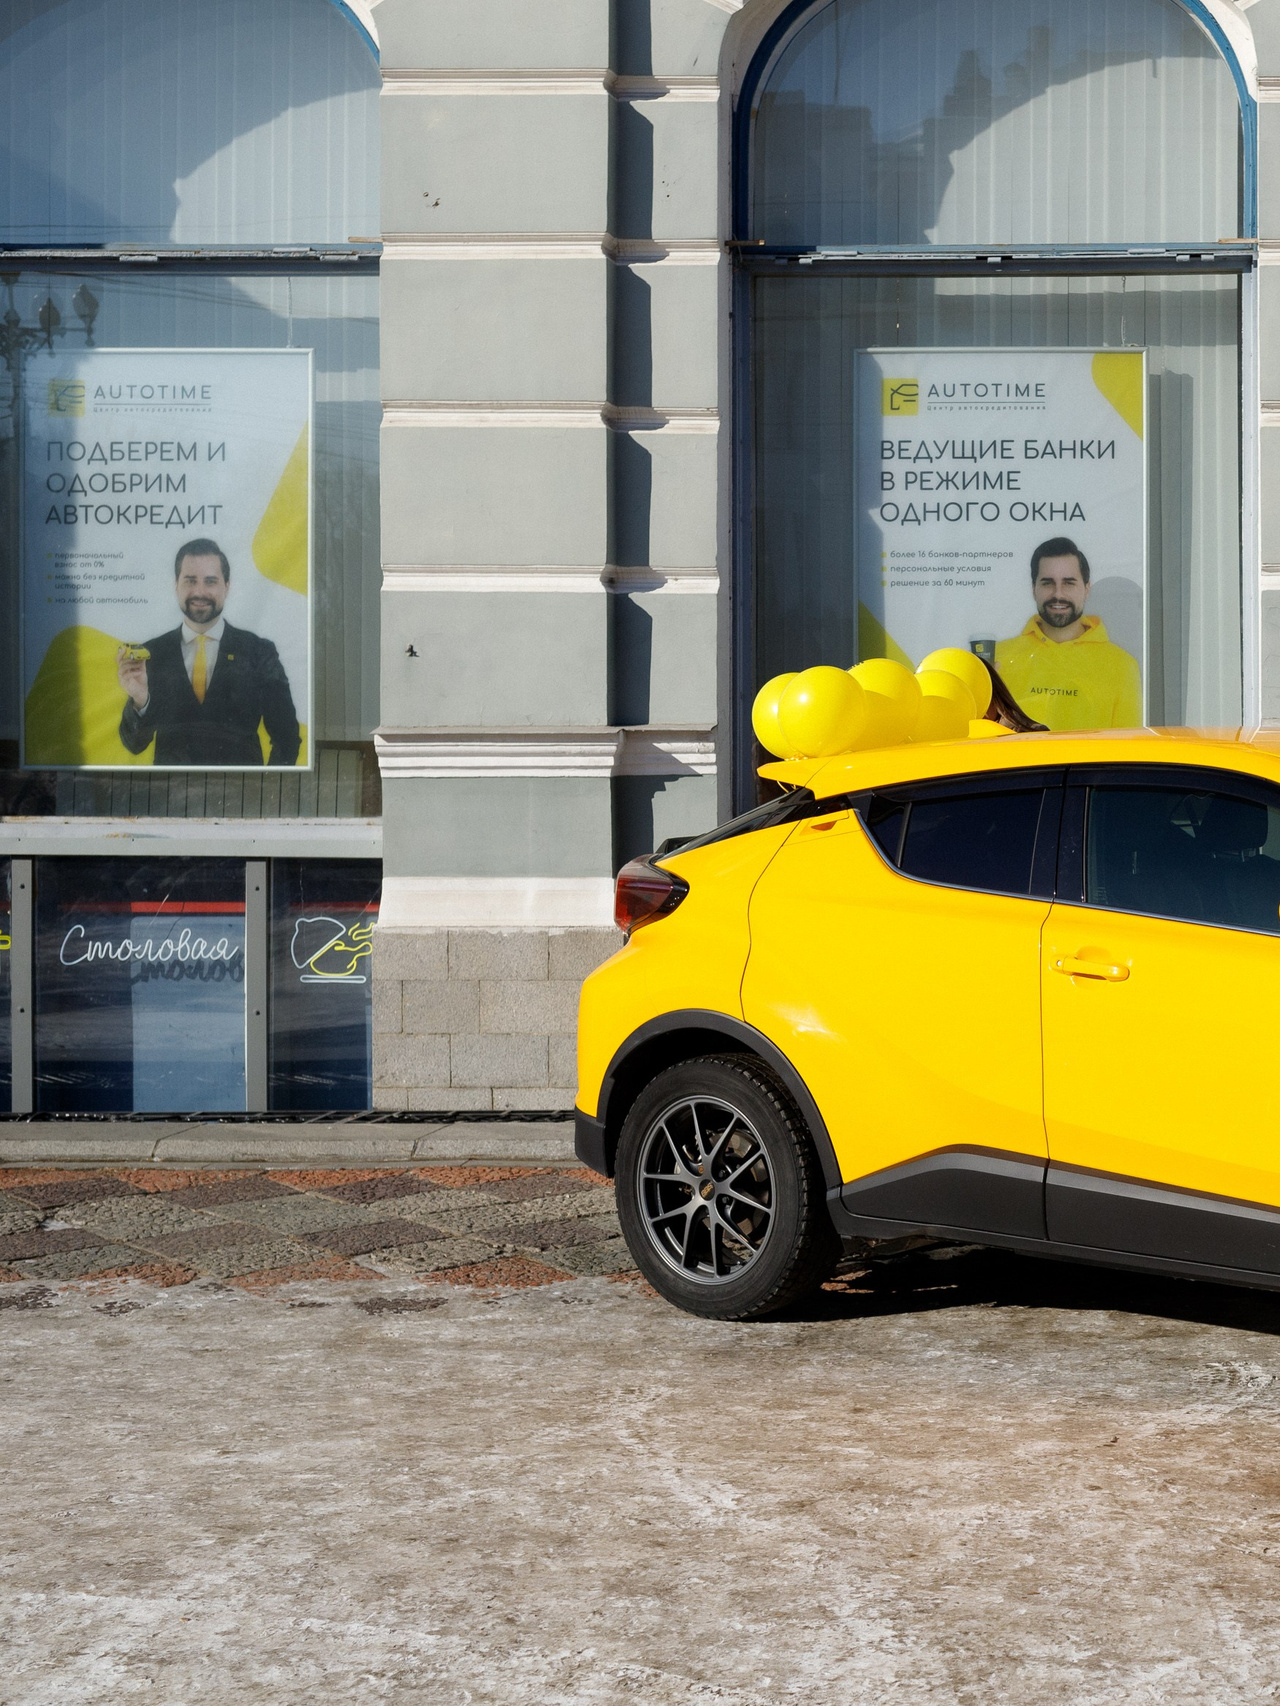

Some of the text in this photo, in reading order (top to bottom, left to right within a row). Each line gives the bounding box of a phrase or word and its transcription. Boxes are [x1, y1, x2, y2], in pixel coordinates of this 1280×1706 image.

[94, 385, 212, 399] AUTOTIME
[927, 383, 1046, 398] AUTOTIME
[47, 441, 226, 465] ПОДБЕРЕМ И
[880, 440, 1115, 463] ВЕДУЩИЕ БАНКИ
[46, 473, 186, 497] ОДОБРИМ
[880, 471, 1021, 491] В РЕЖИМЕ
[45, 505, 223, 529] АВТОКРЕДИТ
[880, 502, 1086, 526] ОДНОГО ОКНА
[890, 550, 916, 558] более
[928, 550, 1014, 560] банков-партнеров
[890, 565, 955, 573] персональные
[890, 580, 930, 588] решение
[943, 579, 954, 587] 60
[955, 580, 986, 588] минут
[1030, 687, 1079, 697] AUTOTIME
[59, 924, 240, 965] Столовая
